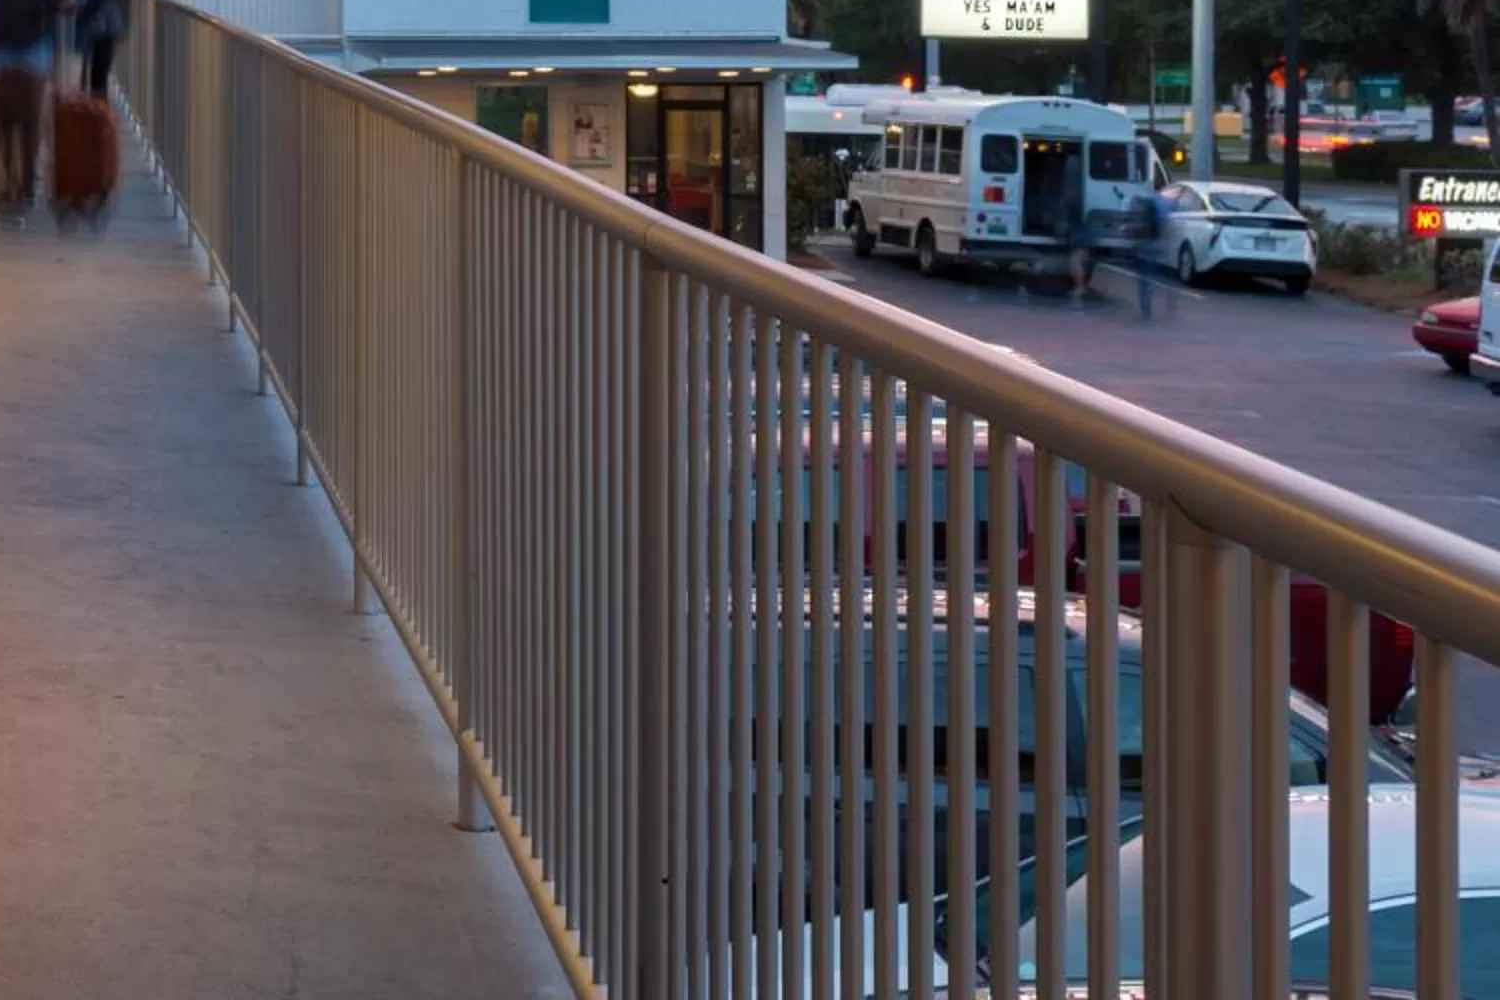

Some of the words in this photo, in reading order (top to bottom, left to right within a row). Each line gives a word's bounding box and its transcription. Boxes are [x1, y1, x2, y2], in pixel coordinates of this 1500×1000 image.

[963, 0, 991, 14] YES
[1006, 0, 1056, 14] MA'AM
[981, 17, 991, 31] &
[1005, 17, 1045, 32] DUDE
[1417, 211, 1440, 229] NO
